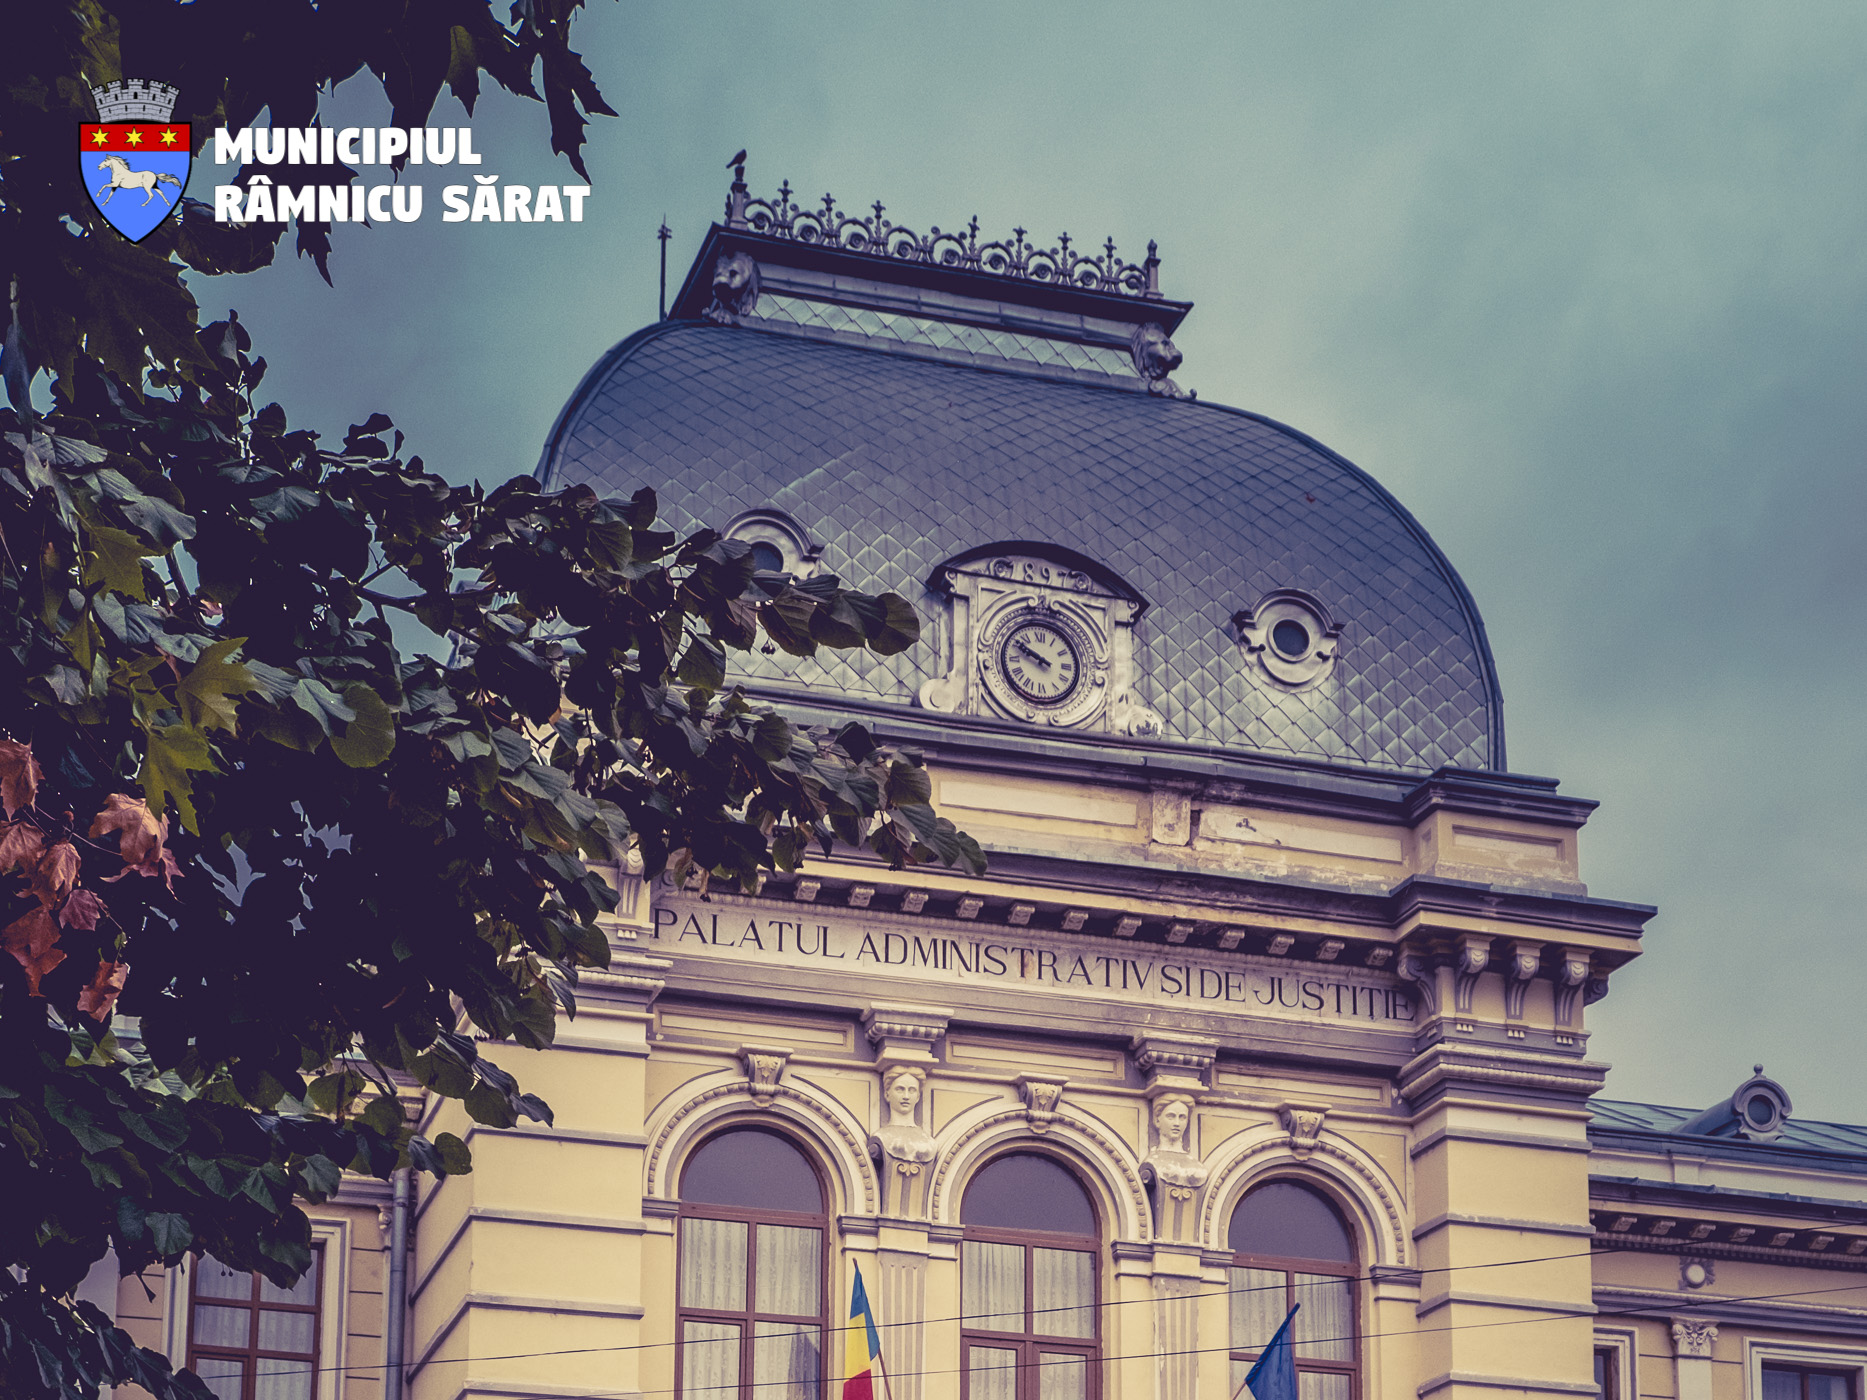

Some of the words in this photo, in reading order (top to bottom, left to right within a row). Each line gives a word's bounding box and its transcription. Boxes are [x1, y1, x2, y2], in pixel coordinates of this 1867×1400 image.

[653, 908, 845, 959] PALATUL
[855, 931, 1155, 991] ADMINISTRATIV
[1200, 967, 1246, 1003] DE
